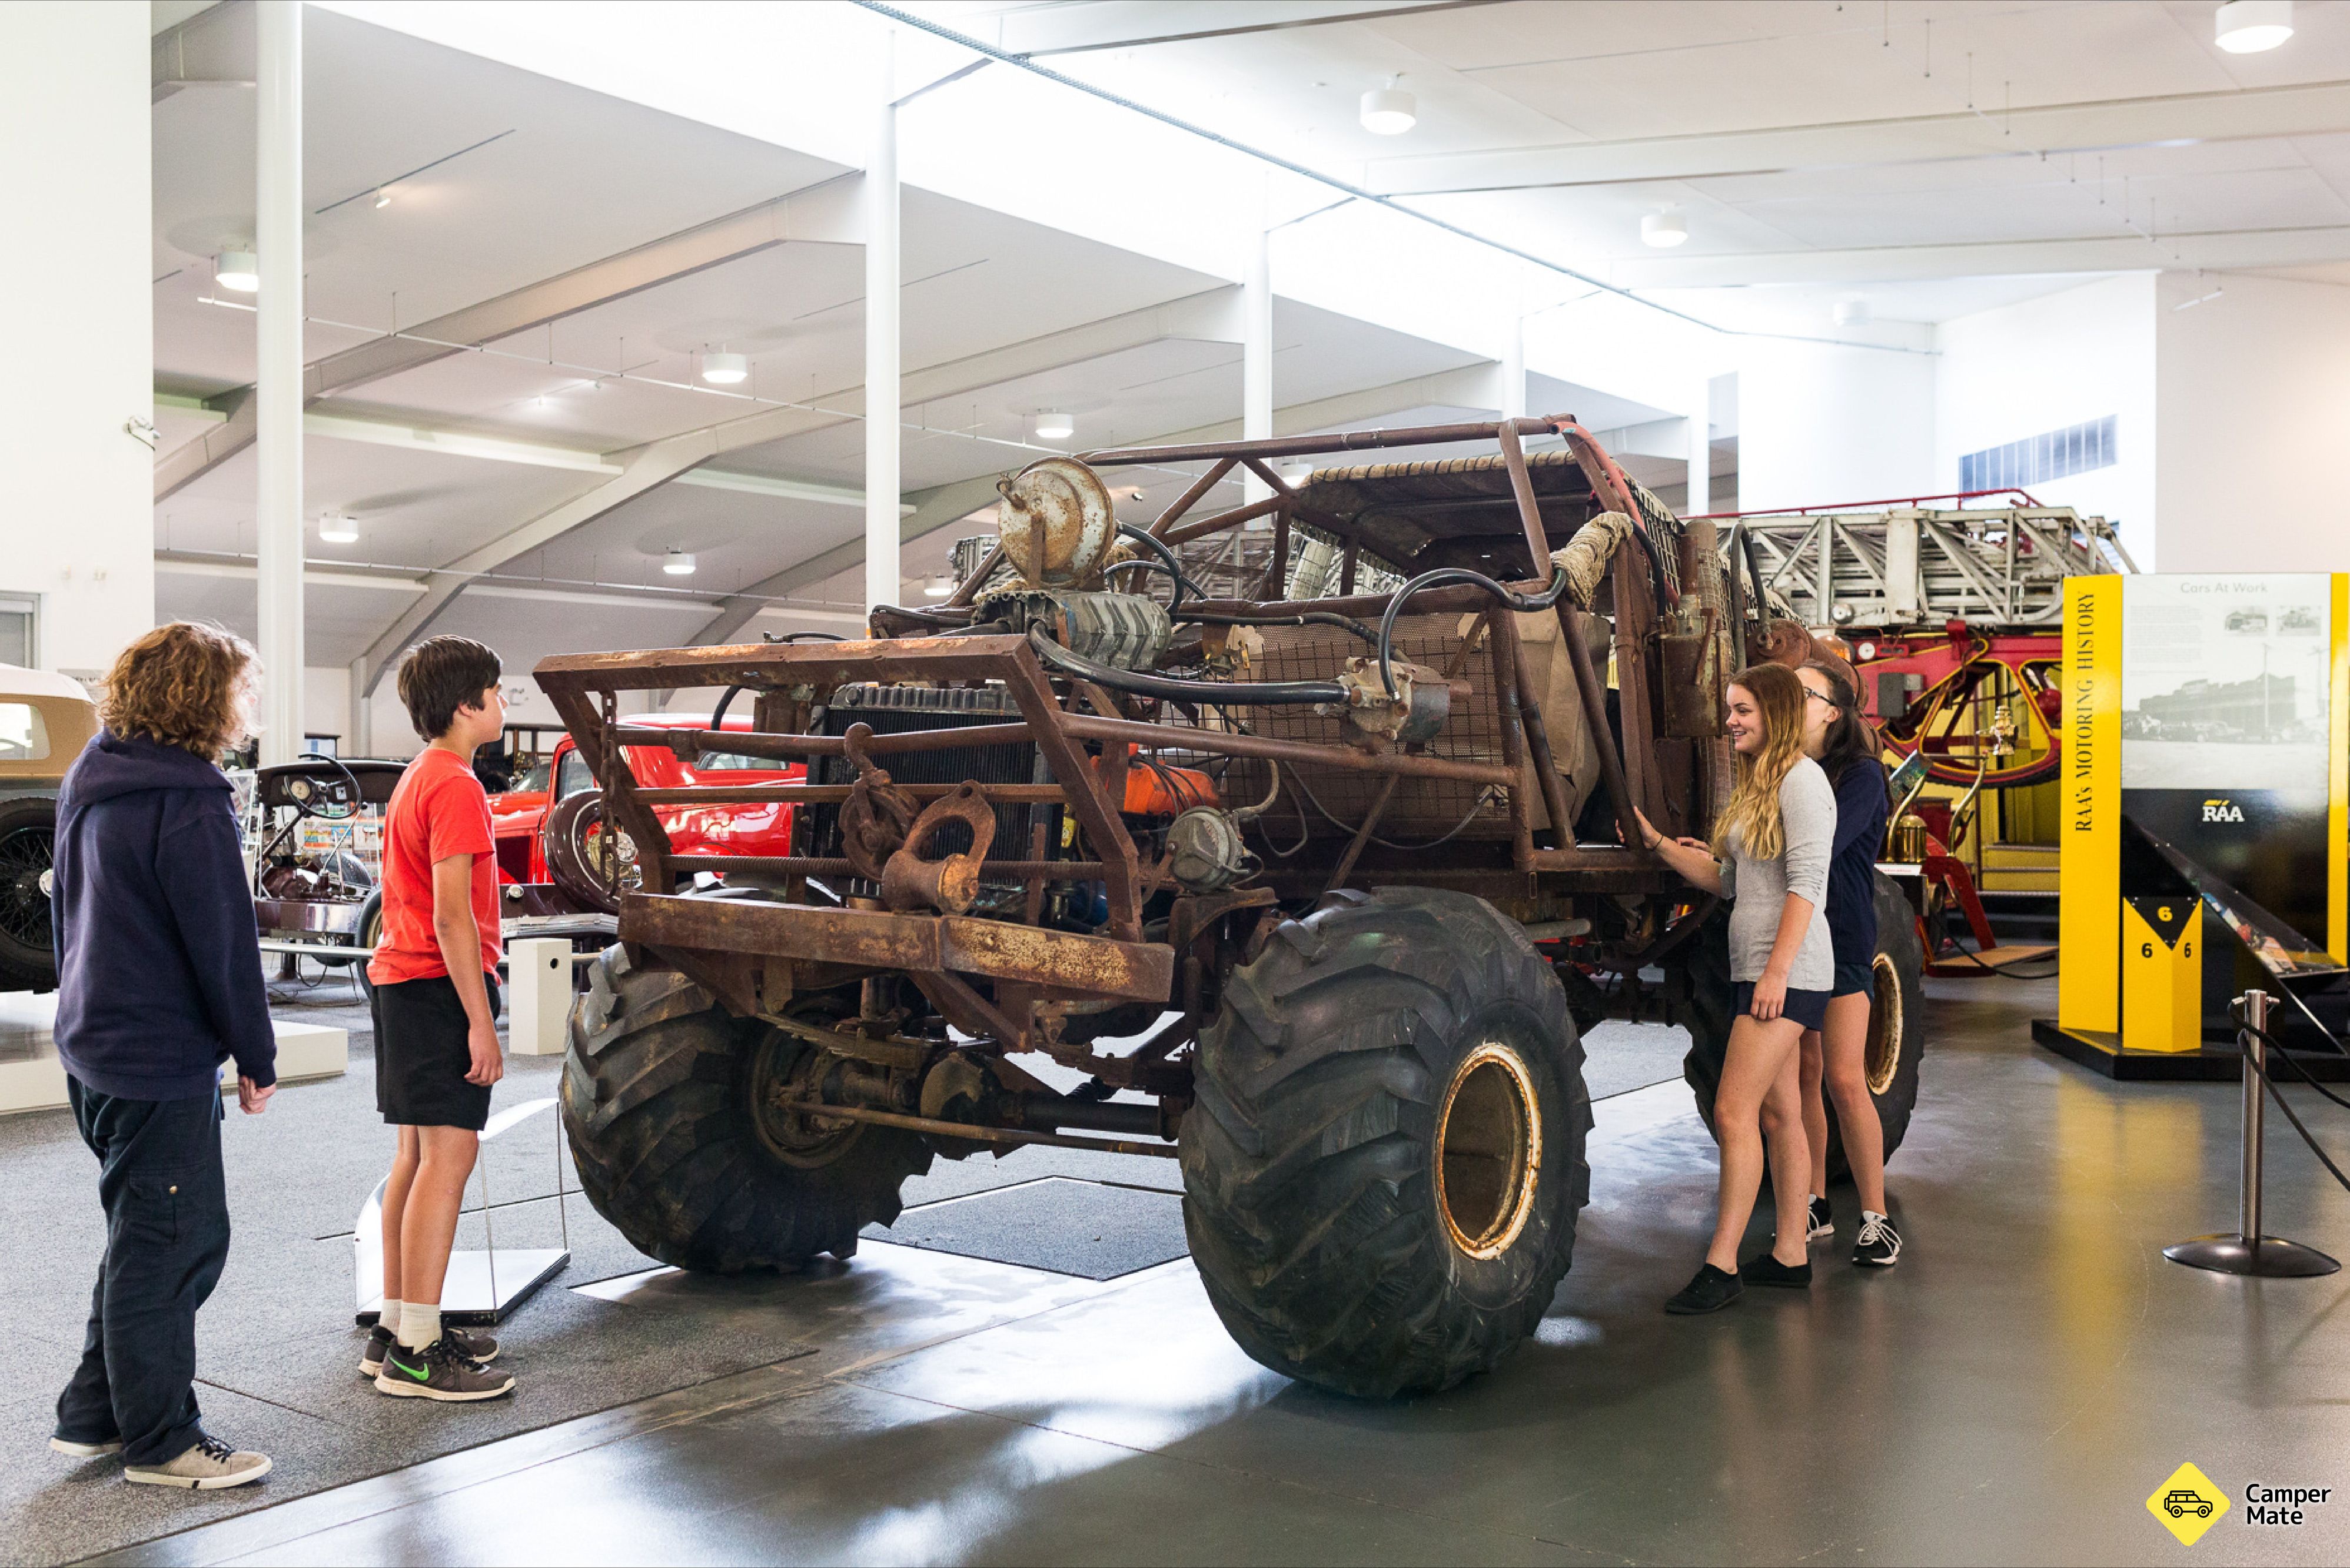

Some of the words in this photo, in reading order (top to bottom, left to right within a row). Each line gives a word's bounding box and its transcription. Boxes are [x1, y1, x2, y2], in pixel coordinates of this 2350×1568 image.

[2180, 582, 2211, 593] Cars
[2215, 582, 2228, 593] At
[2233, 582, 2268, 593] Work
[2076, 590, 2094, 669] HISTORY
[2075, 680, 2093, 780] MOTORING
[2075, 787, 2092, 831] RAA's
[2202, 805, 2245, 822] RAA
[2158, 906, 2173, 922] 6
[2141, 942, 2153, 958] 6
[2184, 942, 2191, 958] 6
